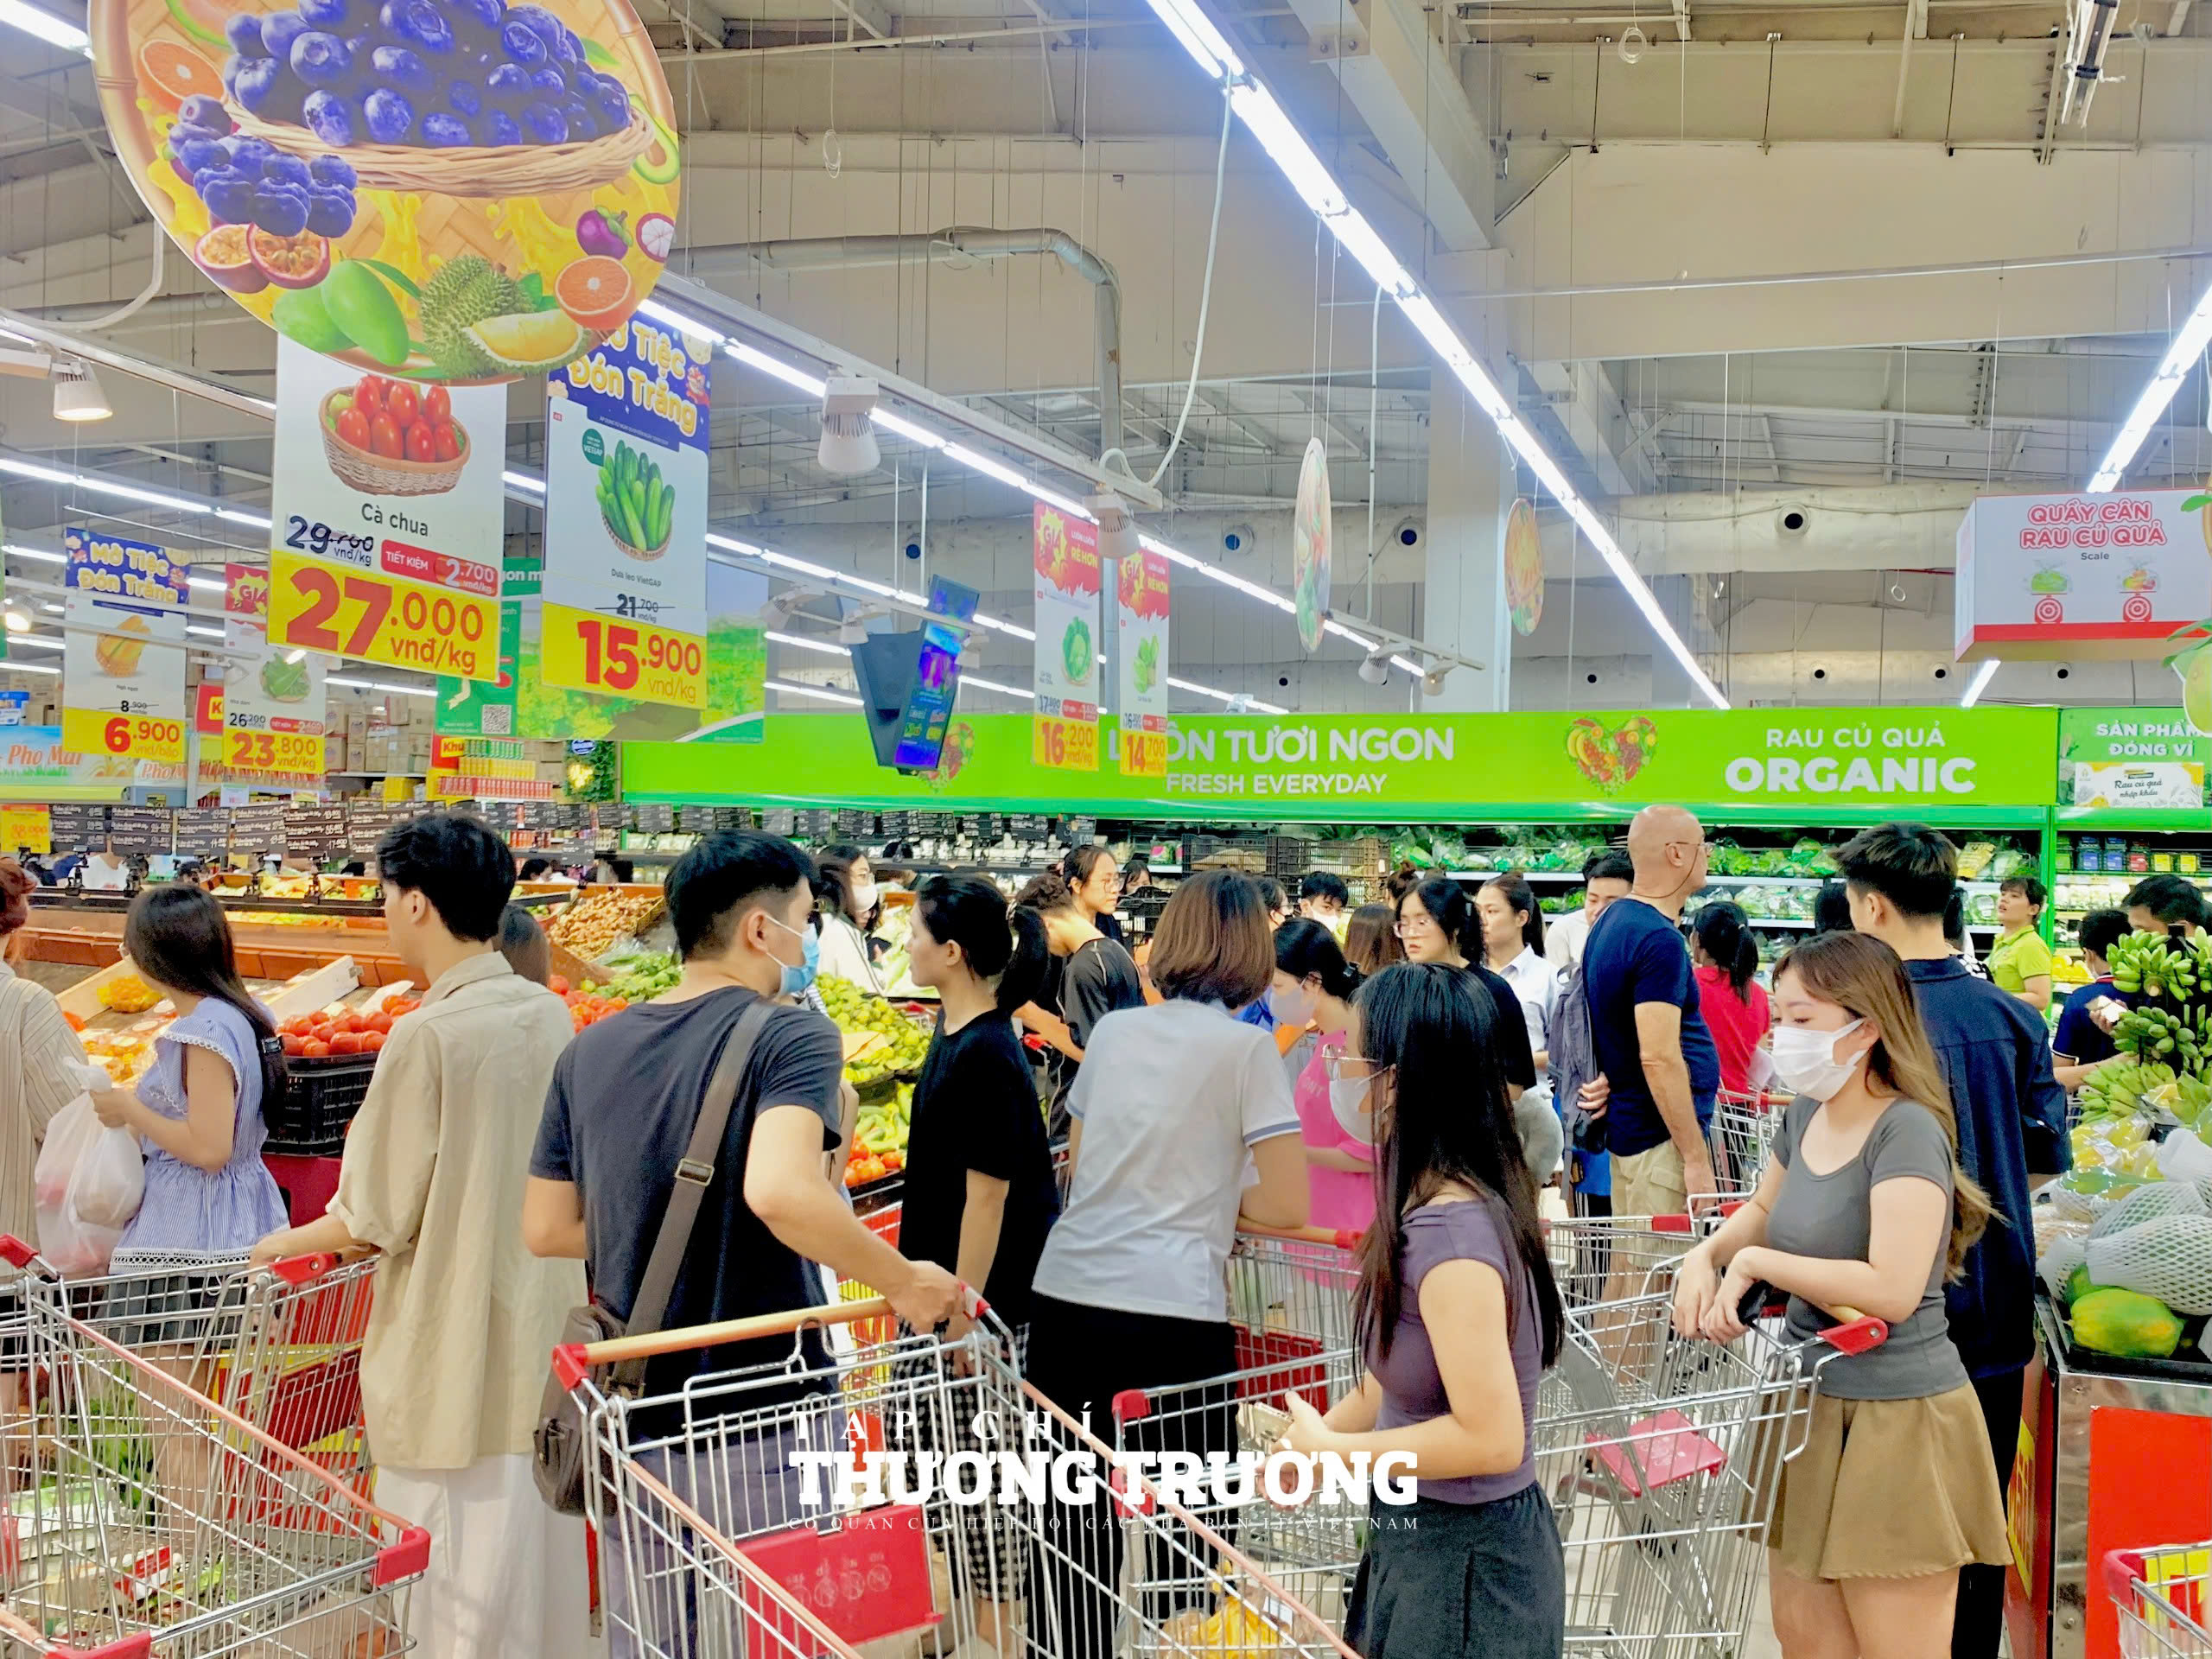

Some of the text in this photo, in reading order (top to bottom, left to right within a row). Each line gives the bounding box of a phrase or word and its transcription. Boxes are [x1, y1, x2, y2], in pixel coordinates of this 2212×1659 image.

[632, 321, 686, 379] Tiệc
[567, 353, 624, 399] Đón
[627, 366, 697, 437] Trăng
[361, 503, 429, 537] Cà chua
[2100, 498, 2152, 523] CÂN
[2020, 519, 2167, 549] RAU CỦ QUẢ
[125, 547, 169, 577] Tiệc
[385, 550, 429, 571] TIẾT KIỆM
[2081, 552, 2109, 561] Scale
[78, 567, 121, 593] Đón
[444, 558, 495, 588] 2.700
[285, 567, 483, 657] 27.000
[391, 635, 476, 676] vnđ/kg
[577, 620, 702, 690] 15.900
[105, 716, 180, 753] 6.900
[1109, 722, 1216, 763] LÔN
[1224, 725, 1316, 763] TƯƠI
[1329, 727, 1454, 763] NGON
[1766, 721, 1945, 748] RAU CỦ QUẢ
[2097, 719, 2138, 736] SẢN
[7, 745, 42, 766] Pho
[232, 732, 317, 767] 23.800
[1041, 721, 1093, 766] 16.200
[142, 762, 171, 779] Pho
[1166, 773, 1388, 794] FRESH EVERYDAY
[1725, 757, 1977, 794] ORGANIC
[2114, 780, 2133, 789] Rau
